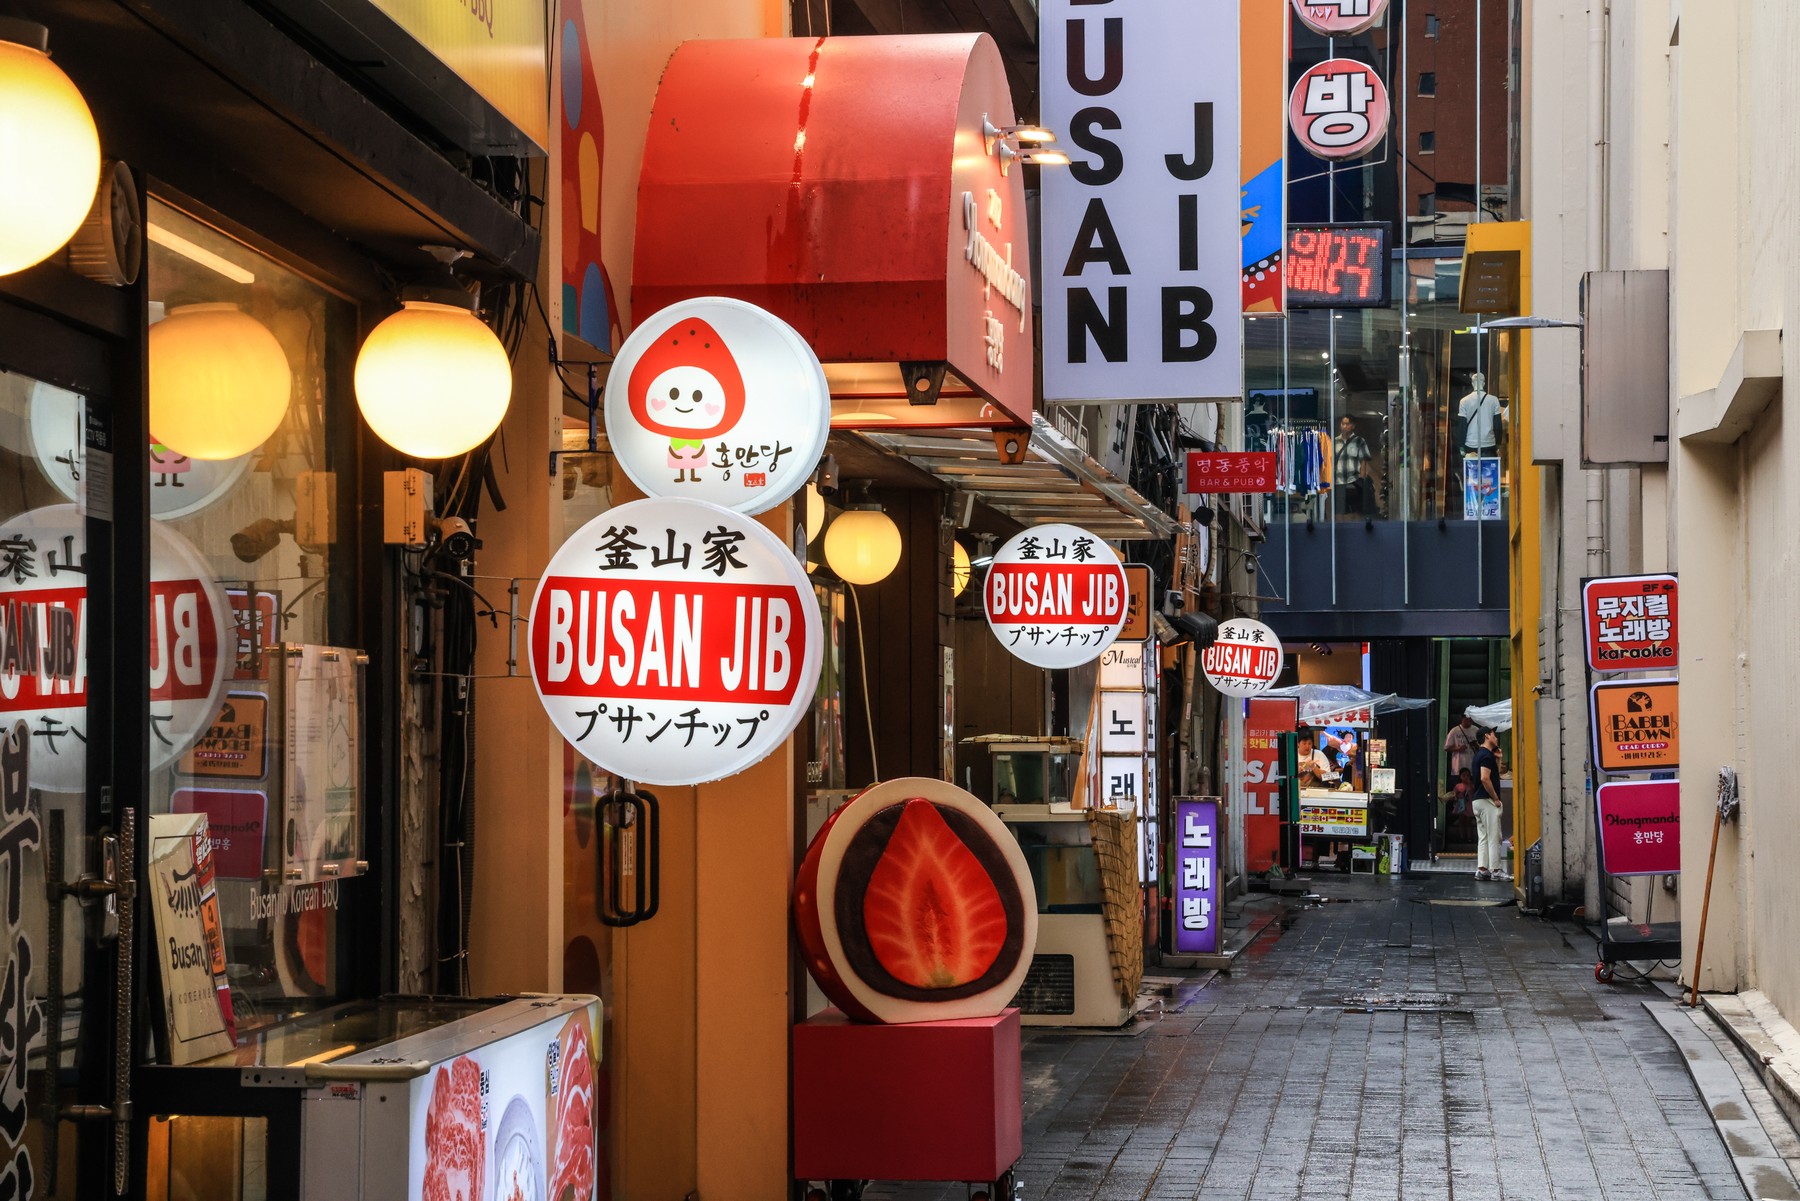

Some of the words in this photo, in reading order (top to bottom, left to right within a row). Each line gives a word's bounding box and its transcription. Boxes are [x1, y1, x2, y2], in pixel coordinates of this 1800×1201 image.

[1062, 0, 1131, 364] USAN
[1163, 102, 1217, 363] JIB
[711, 440, 792, 481] 홍만당
[1200, 478, 1220, 486] BAR
[1222, 478, 1230, 486] &
[1233, 478, 1254, 486] PUB
[595, 525, 748, 577] 釜山家
[1017, 536, 1096, 562] 釜山家
[992, 572, 1073, 616] BUSAN
[1082, 573, 1119, 616] JIB
[1642, 584, 1659, 592] 2F
[1597, 594, 1669, 619] 뮤지컬
[548, 589, 703, 688] BUSAN
[720, 596, 792, 691] JIB
[1009, 625, 1110, 647] プサンチップ
[1223, 626, 1265, 643] 釜山家
[1598, 619, 1671, 642] 노래방
[1102, 650, 1142, 666] Musical
[1206, 646, 1252, 675] BUSAN
[1254, 649, 1276, 677] JIB
[1598, 644, 1673, 660] karaoke
[575, 703, 770, 748] プサンチップ
[1612, 714, 1670, 730] BABBI
[1613, 729, 1671, 742] BROWN
[1633, 831, 1664, 844] 홍만당
[1182, 815, 1212, 931] 노래방
[290, 886, 319, 914] Korean
